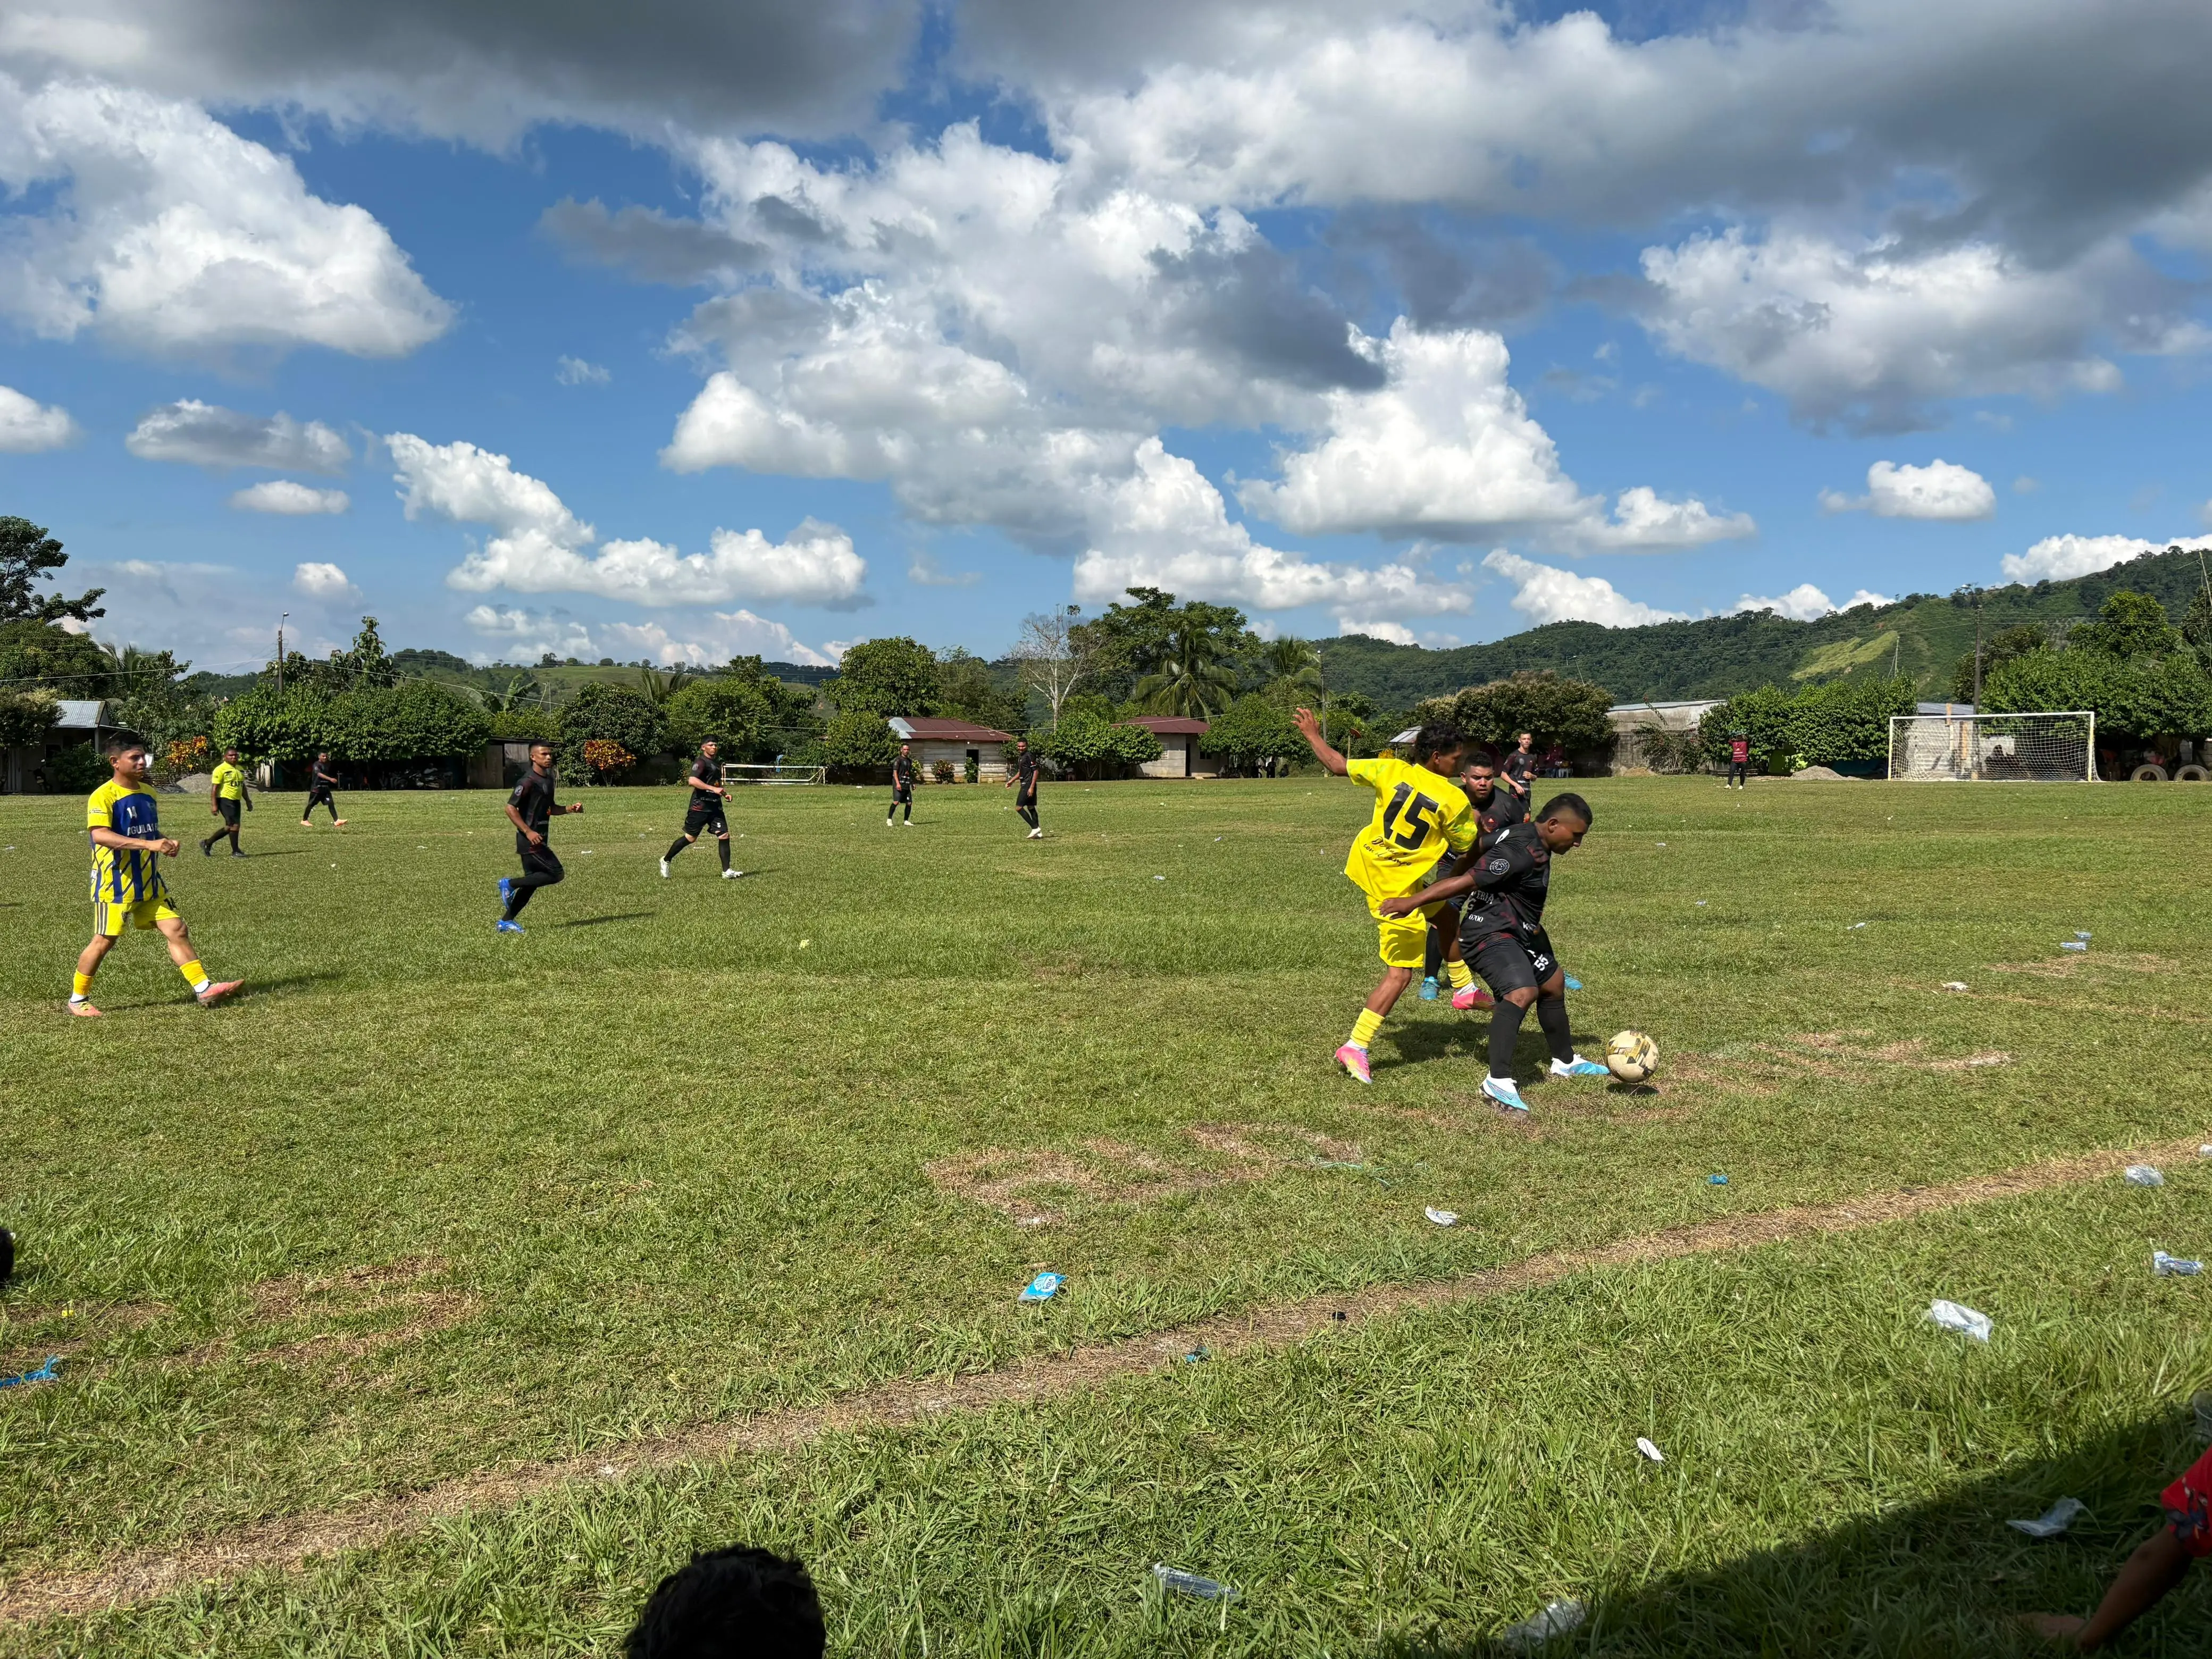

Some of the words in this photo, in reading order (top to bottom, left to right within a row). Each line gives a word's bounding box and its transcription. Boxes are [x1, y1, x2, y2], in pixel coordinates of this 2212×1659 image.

[127, 806, 137, 818] 14
[1383, 782, 1439, 850] 15
[1043, 1278, 1054, 1289] VIDA
